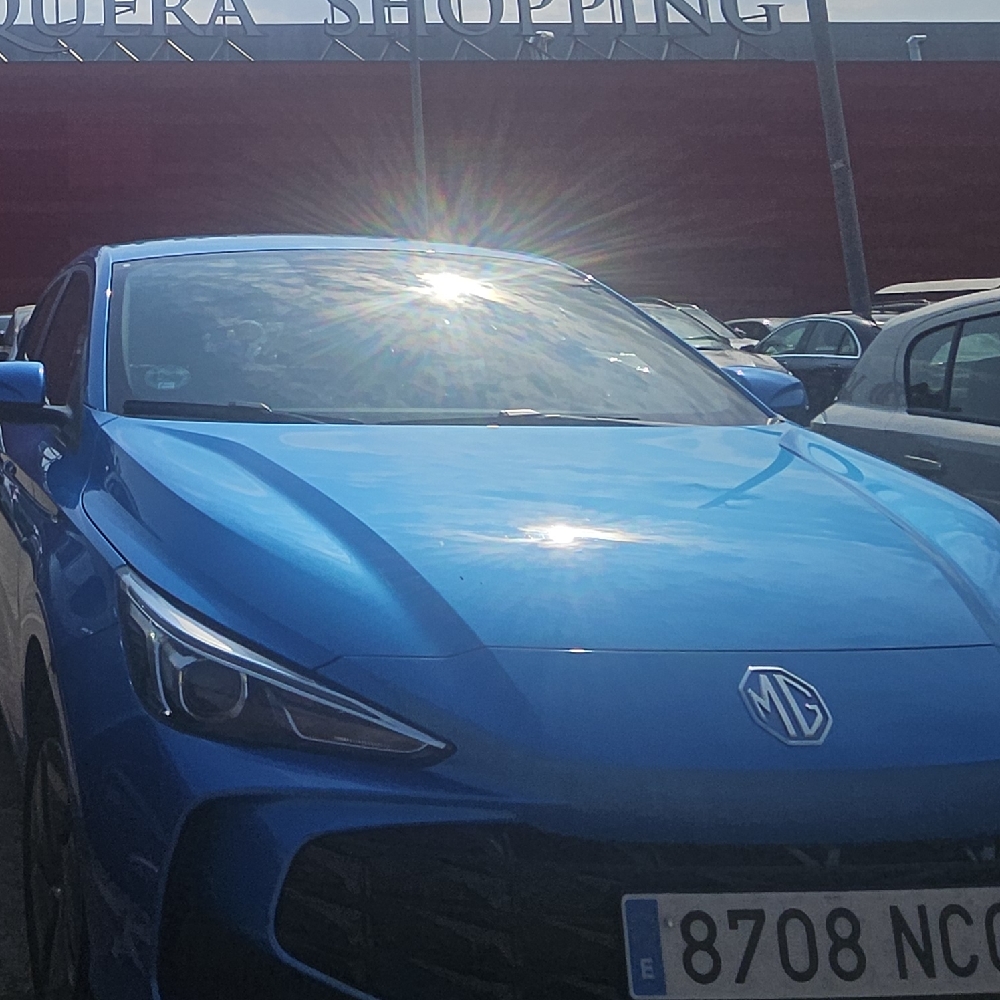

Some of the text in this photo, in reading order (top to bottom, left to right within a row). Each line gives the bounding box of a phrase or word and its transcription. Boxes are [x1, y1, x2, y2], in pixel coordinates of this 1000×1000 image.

[748, 673, 823, 737] MG
[641, 957, 656, 980] E
[680, 907, 867, 985] 8708
